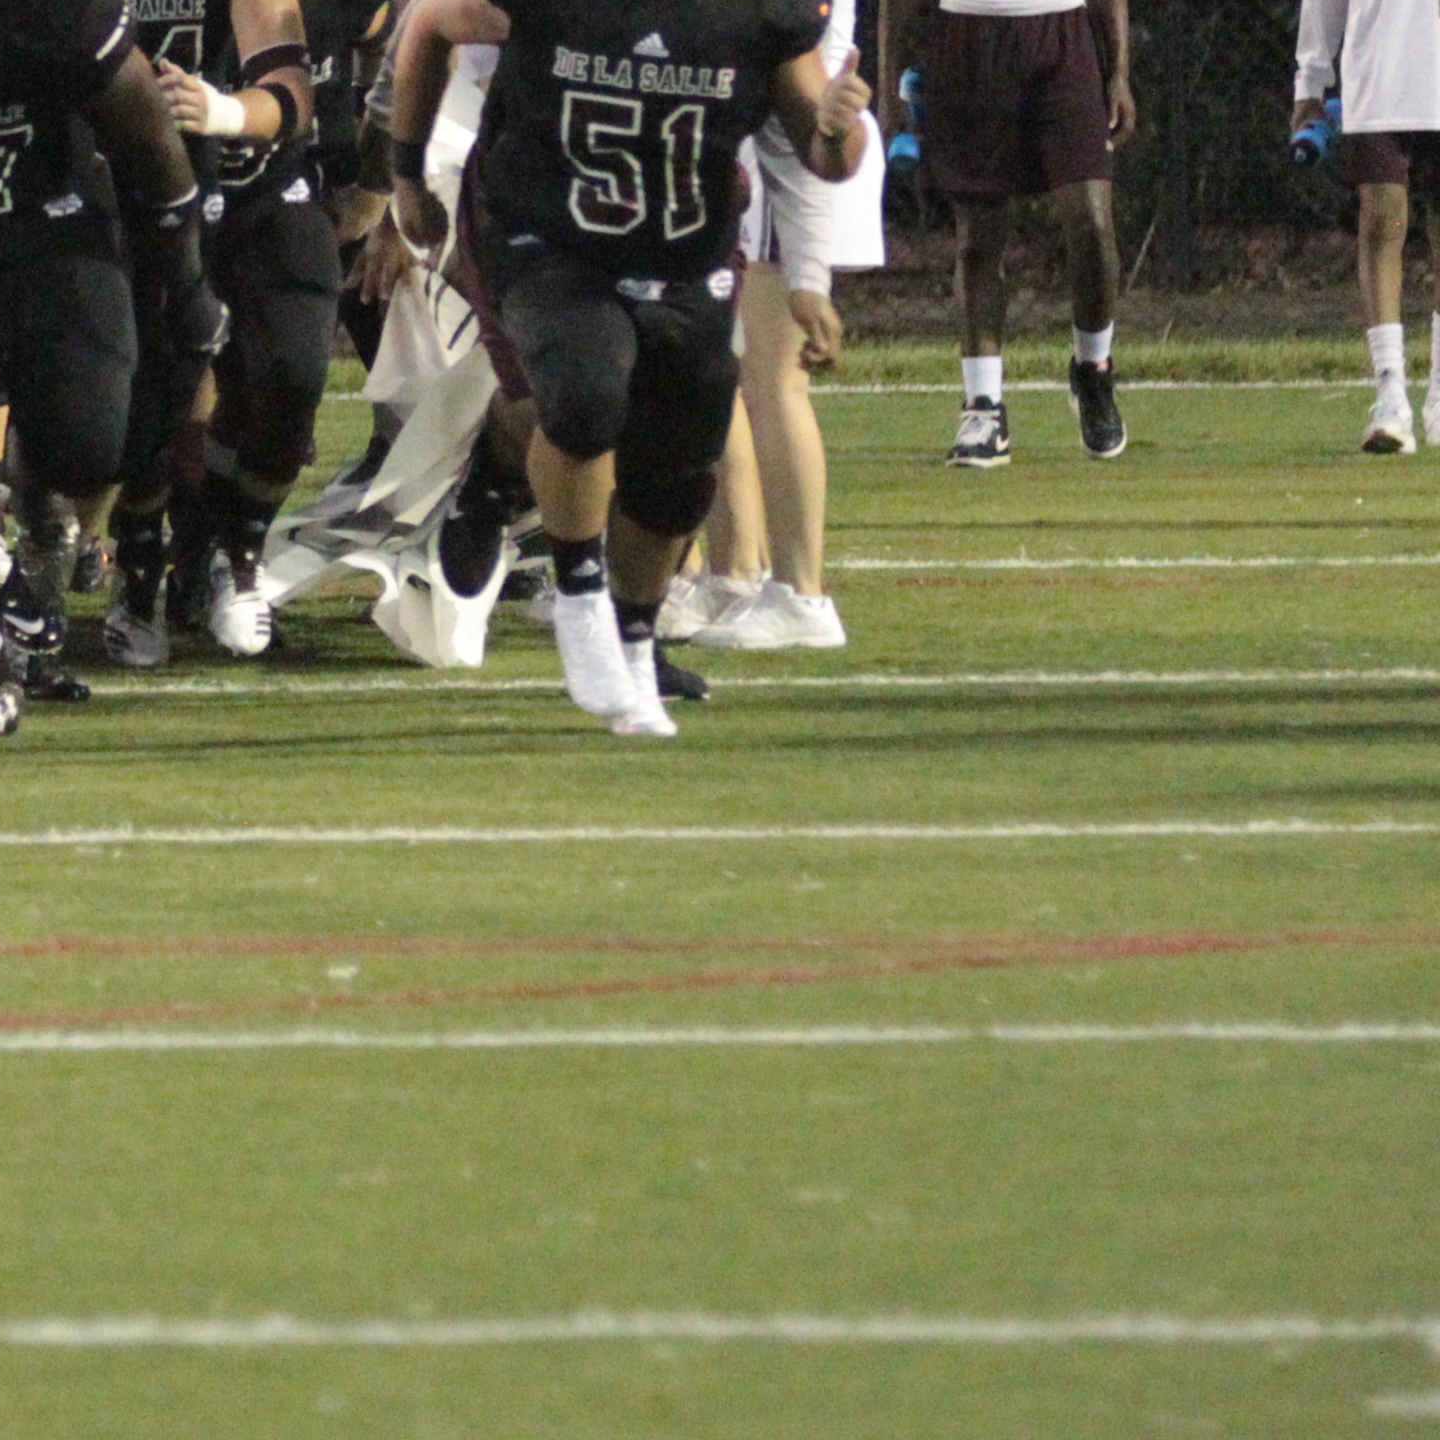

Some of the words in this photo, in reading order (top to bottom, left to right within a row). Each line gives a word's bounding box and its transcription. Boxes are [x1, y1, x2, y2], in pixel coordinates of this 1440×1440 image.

[553, 46, 589, 83] DE
[592, 56, 633, 90] LA
[638, 63, 736, 100] SALLE
[561, 90, 707, 241] 51
